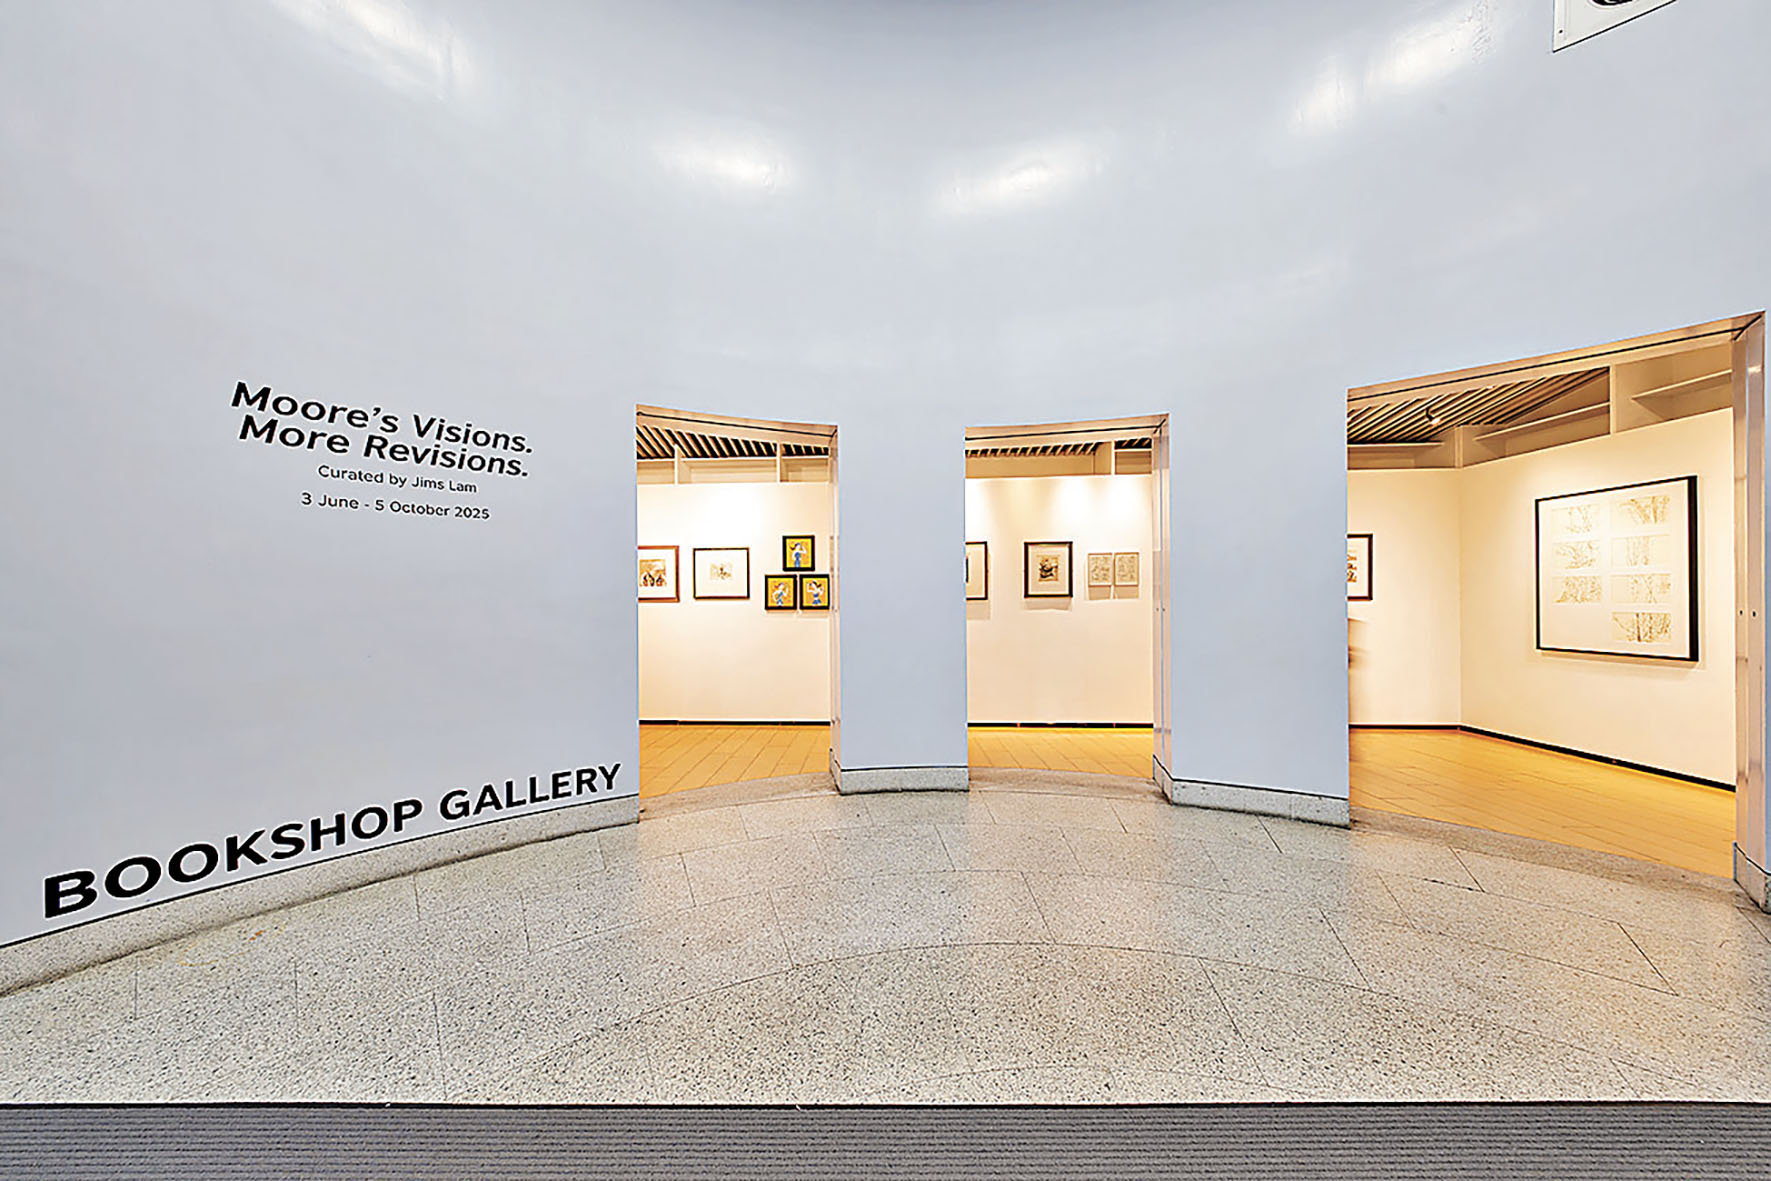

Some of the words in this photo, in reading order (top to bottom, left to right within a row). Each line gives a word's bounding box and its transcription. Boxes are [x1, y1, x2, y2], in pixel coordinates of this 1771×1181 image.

[239, 414, 350, 454] More
[363, 434, 529, 477] Revisions.
[413, 414, 533, 453] Visions.
[318, 464, 384, 484] Curated
[389, 473, 407, 489] by
[411, 475, 445, 490] Jims
[449, 480, 477, 493] Lam
[301, 492, 312, 506] 3
[318, 494, 359, 510] June
[375, 499, 385, 512] 5
[389, 500, 451, 517] October
[454, 506, 490, 520] 2025
[45, 800, 422, 918] BOOKSHOP
[440, 764, 620, 820] GALLERY
